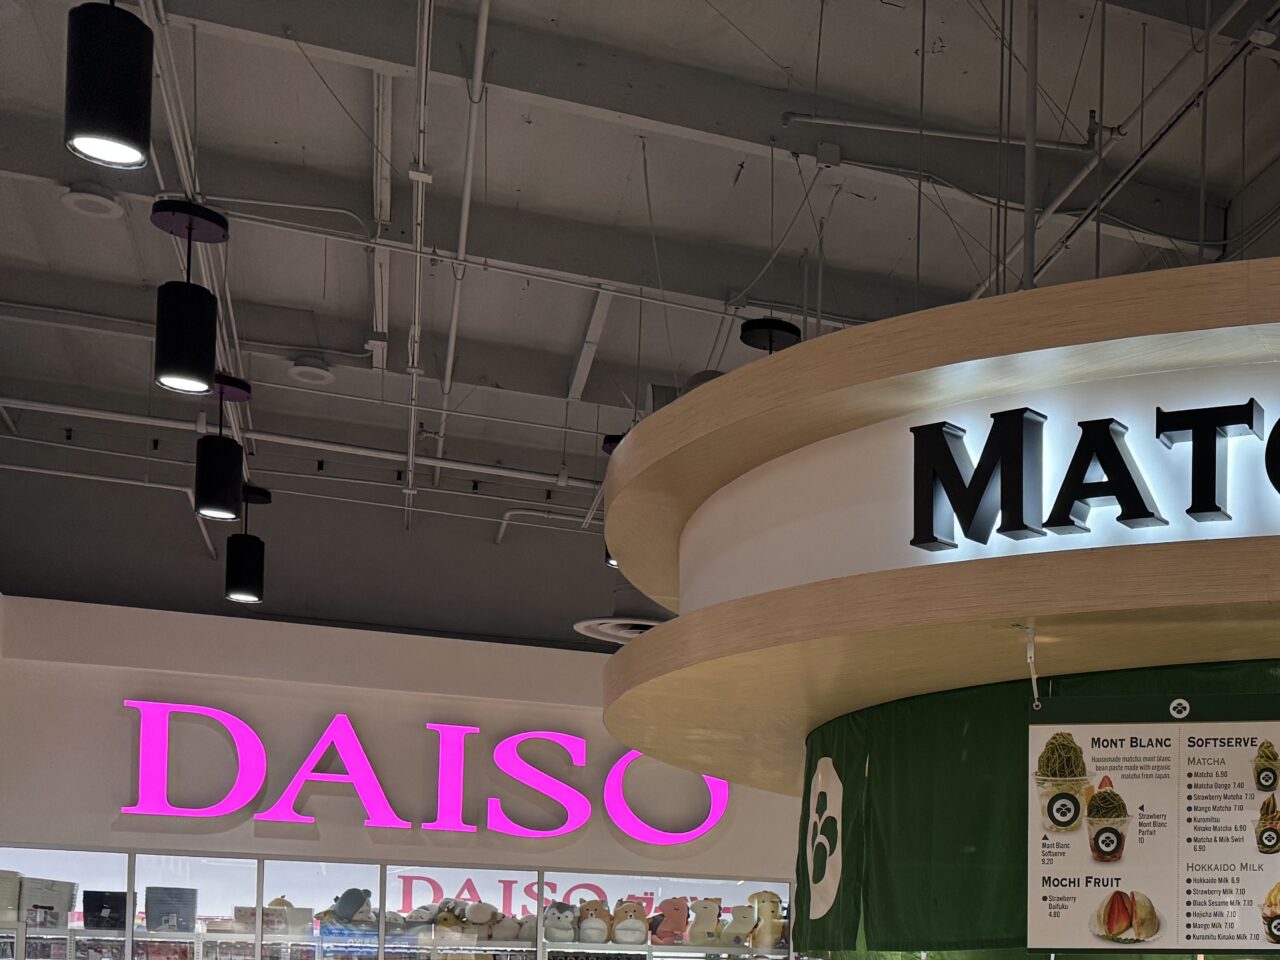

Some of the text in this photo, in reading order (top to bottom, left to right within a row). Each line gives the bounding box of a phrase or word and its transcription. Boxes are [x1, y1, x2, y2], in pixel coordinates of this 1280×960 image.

[1091, 736, 1172, 748] MONT BLANC
[1187, 736, 1258, 748] SOFTSERVE
[1187, 756, 1226, 766] MATCHA
[121, 698, 730, 846] DAISO
[1108, 764, 1123, 772] paste
[1194, 824, 1246, 832] Kinako Matcha 6.90
[1186, 862, 1264, 872] HOKKAIDO MILK
[1042, 876, 1122, 888] MOCHI FRUIT
[1193, 888, 1221, 896] Strawberry
[1193, 922, 1210, 930] Mango
